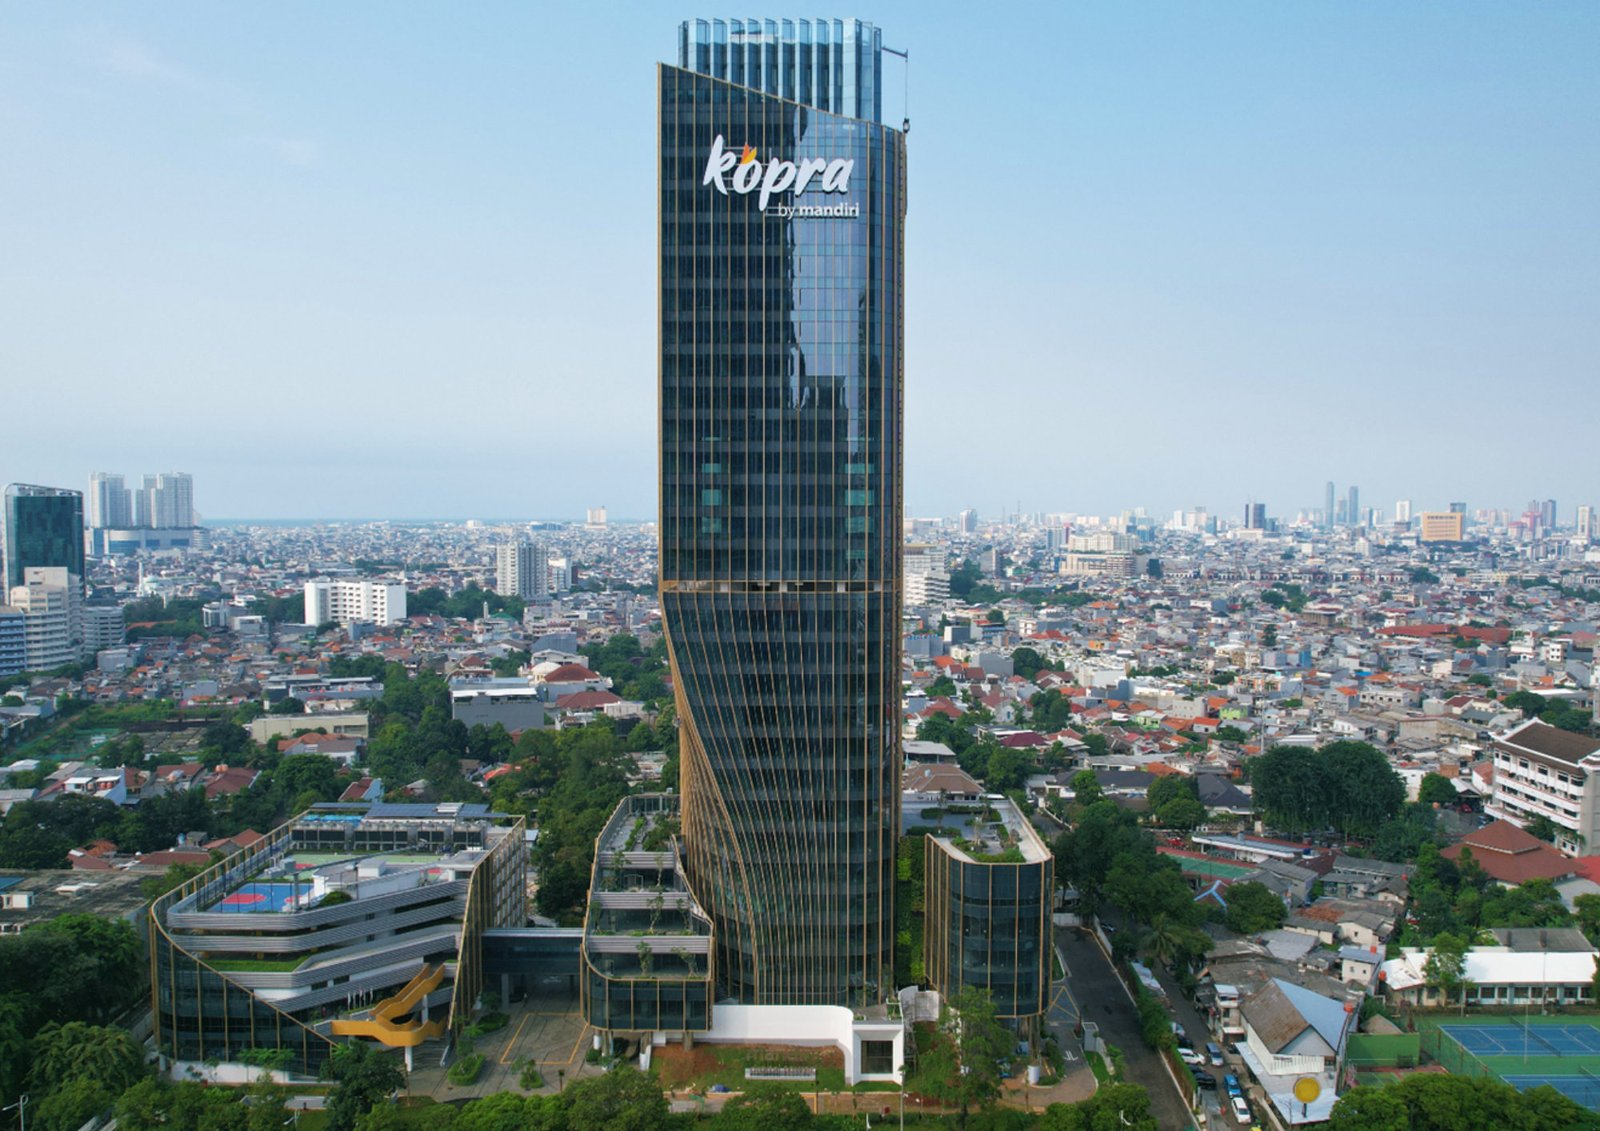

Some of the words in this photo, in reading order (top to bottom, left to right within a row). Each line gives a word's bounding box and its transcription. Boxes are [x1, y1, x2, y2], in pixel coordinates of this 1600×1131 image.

[703, 134, 854, 211] kopra
[778, 202, 795, 219] by
[800, 202, 859, 217] mandiri
